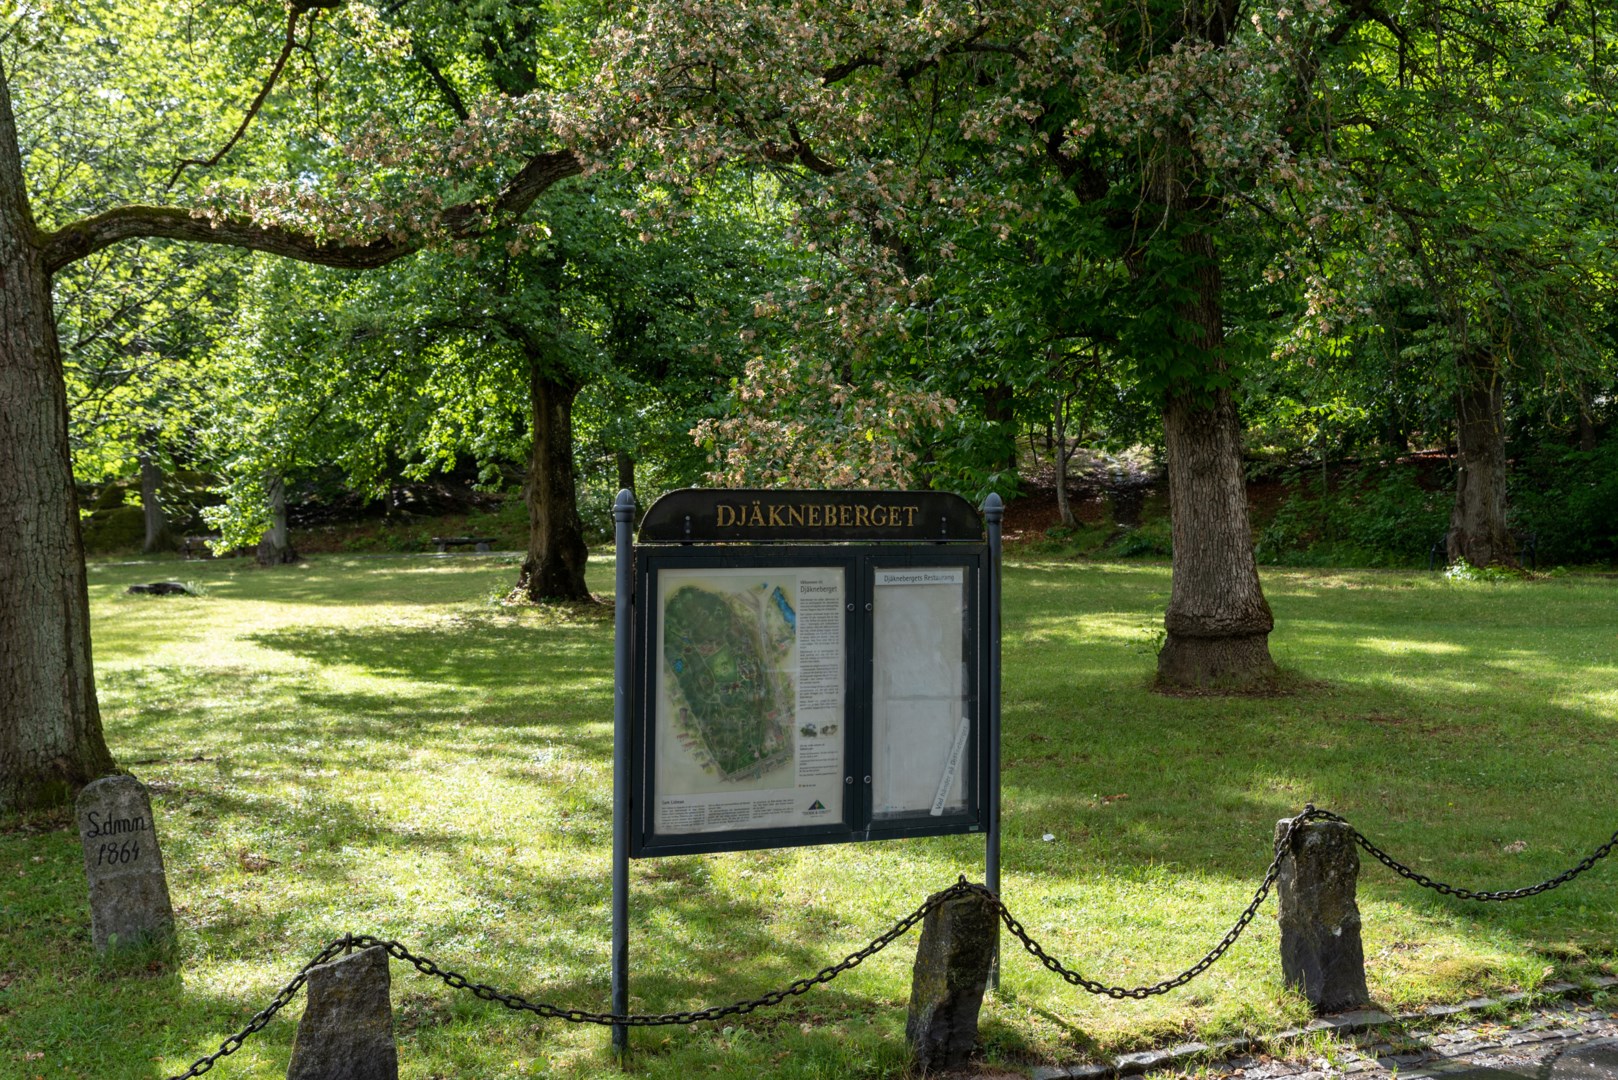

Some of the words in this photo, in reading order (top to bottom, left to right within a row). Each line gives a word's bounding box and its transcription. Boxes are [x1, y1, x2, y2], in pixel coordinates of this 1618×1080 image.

[716, 500, 919, 527] DJÄKNEBERGET
[883, 574, 923, 584] Djäknebergets
[800, 585, 838, 594] Djäkneberget
[97, 840, 140, 866] 1864
